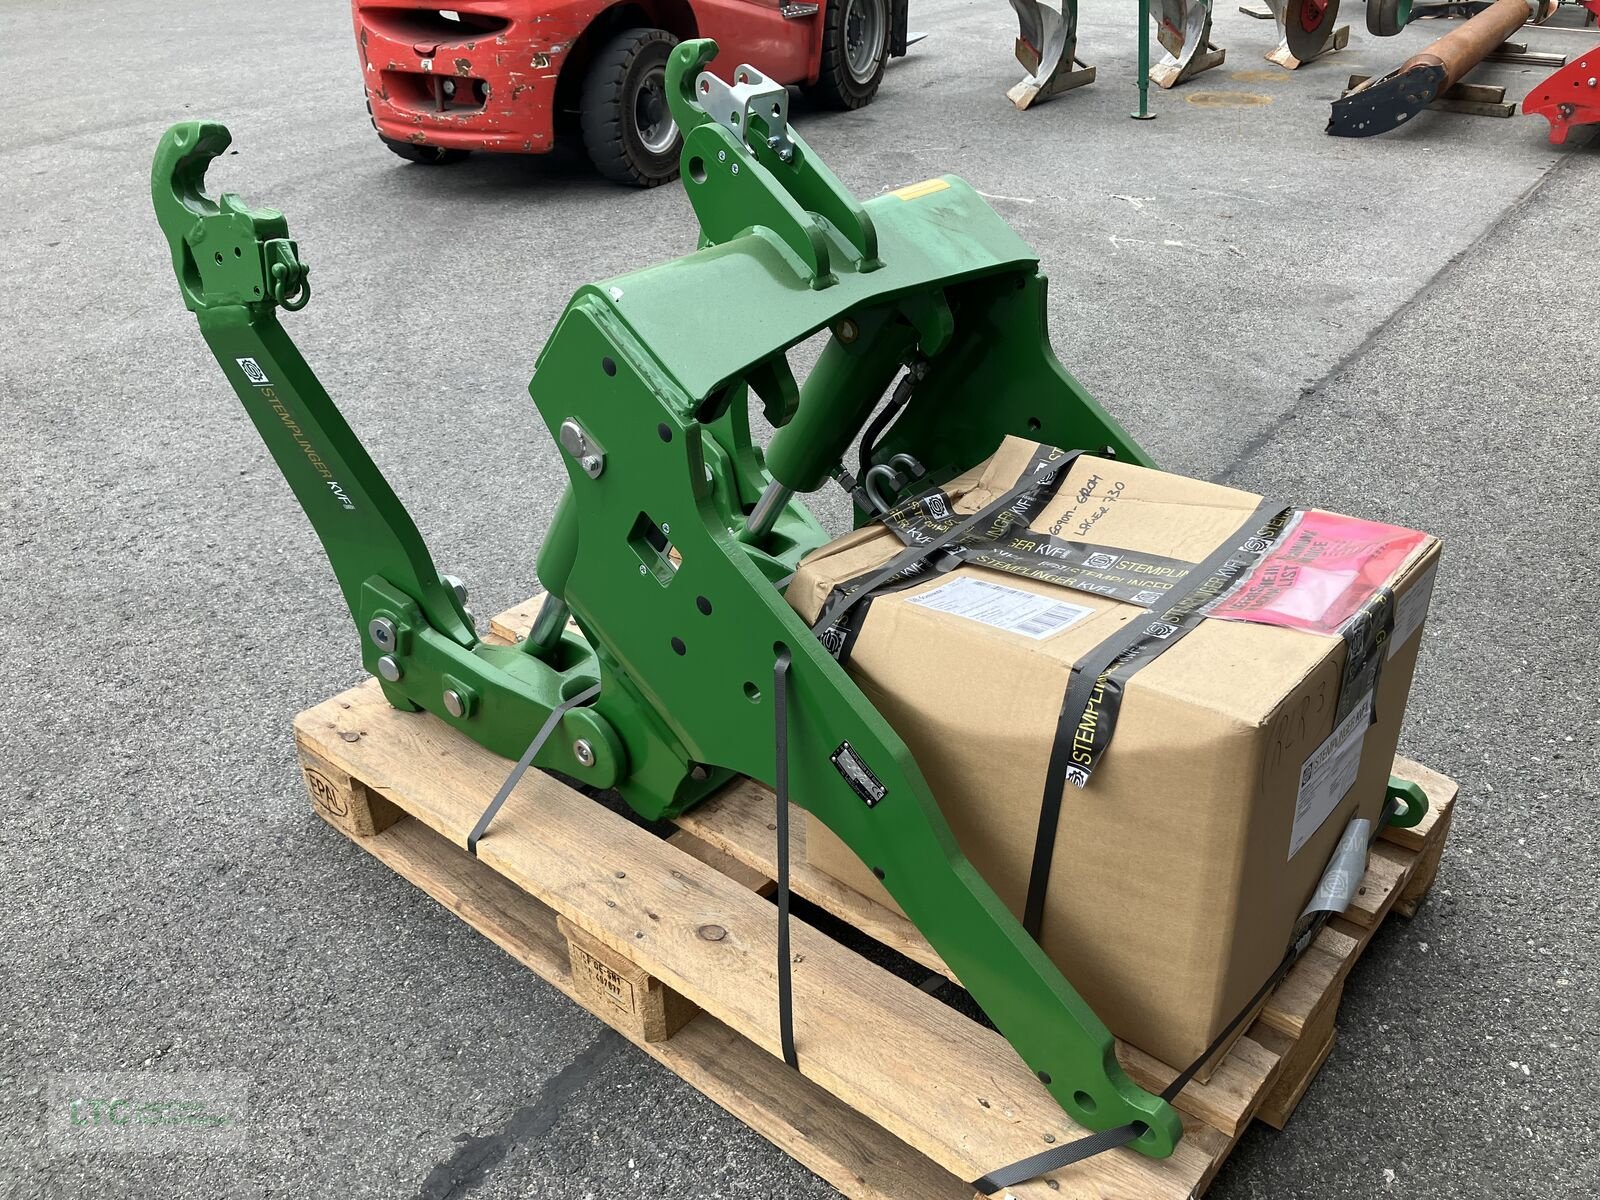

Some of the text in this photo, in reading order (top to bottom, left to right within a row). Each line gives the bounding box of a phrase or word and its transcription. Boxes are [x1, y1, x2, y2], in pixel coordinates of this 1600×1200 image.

[261, 387, 352, 505] STEMPLINGER KVF
[1102, 481, 1126, 503] 730
[1009, 499, 1031, 517] KVF
[1035, 543, 1059, 557] KVF
[976, 556, 1075, 586] STEMPLINGER
[1077, 581, 1107, 595] KVF
[1277, 565, 1299, 587] LIST
